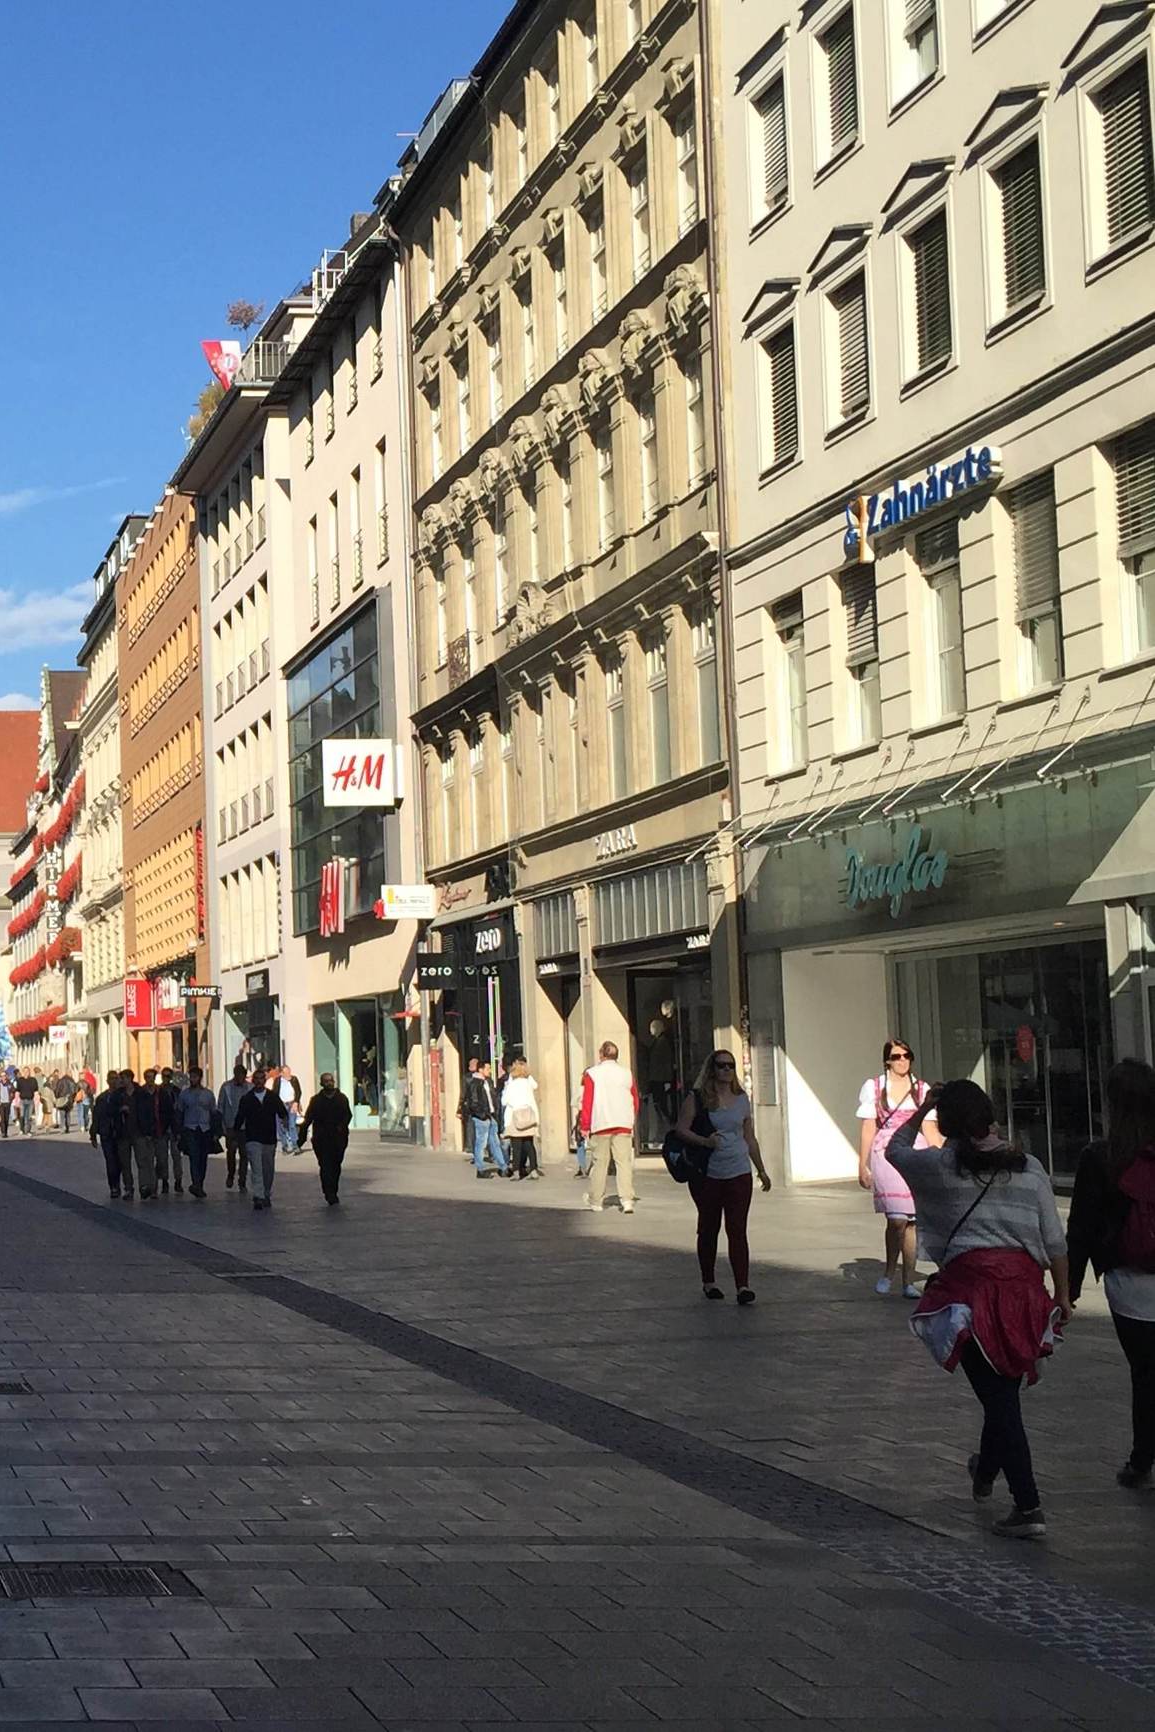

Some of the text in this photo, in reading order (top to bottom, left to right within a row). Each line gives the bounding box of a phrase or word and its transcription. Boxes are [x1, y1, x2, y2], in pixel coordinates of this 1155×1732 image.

[867, 446, 992, 535] Zahnärzte
[332, 754, 385, 791] H&M
[595, 824, 638, 858] ZARA
[844, 823, 949, 919] Douglas
[475, 927, 501, 953] zero
[420, 966, 453, 976] zero
